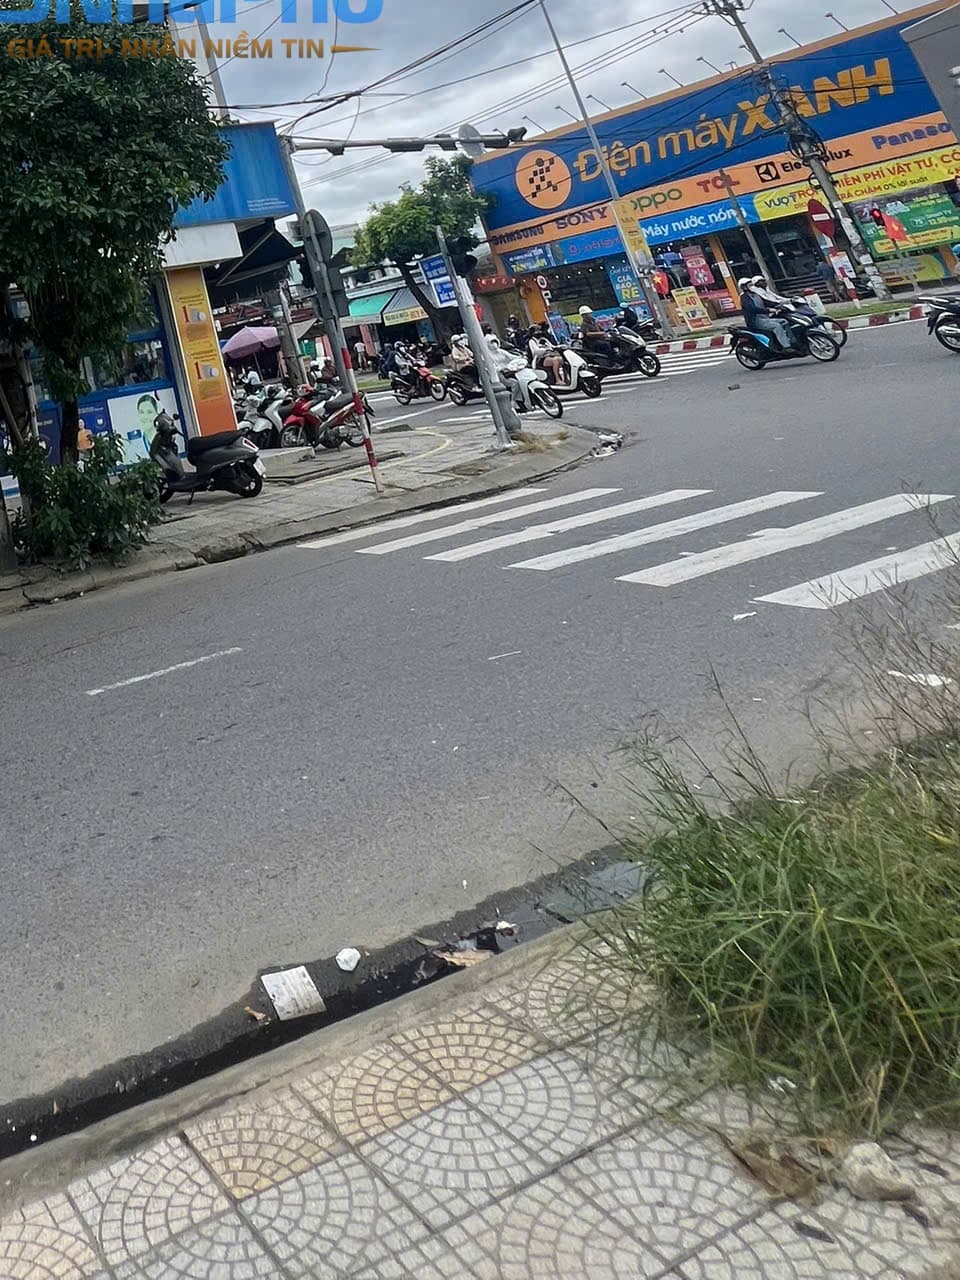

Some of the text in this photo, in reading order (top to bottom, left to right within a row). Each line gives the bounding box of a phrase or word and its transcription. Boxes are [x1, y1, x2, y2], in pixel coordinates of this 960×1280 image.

[573, 58, 894, 182] Điện máy XANH
[555, 206, 607, 230] SONY
[696, 174, 740, 193] TCL
[872, 122, 952, 150] Panaso
[863, 166, 886, 182] PHÍ
[887, 162, 911, 177] VẬT
[839, 191, 854, 201] RẢ
[883, 183, 896, 191] 0%
[642, 221, 670, 238] Máy
[672, 214, 706, 232] nước
